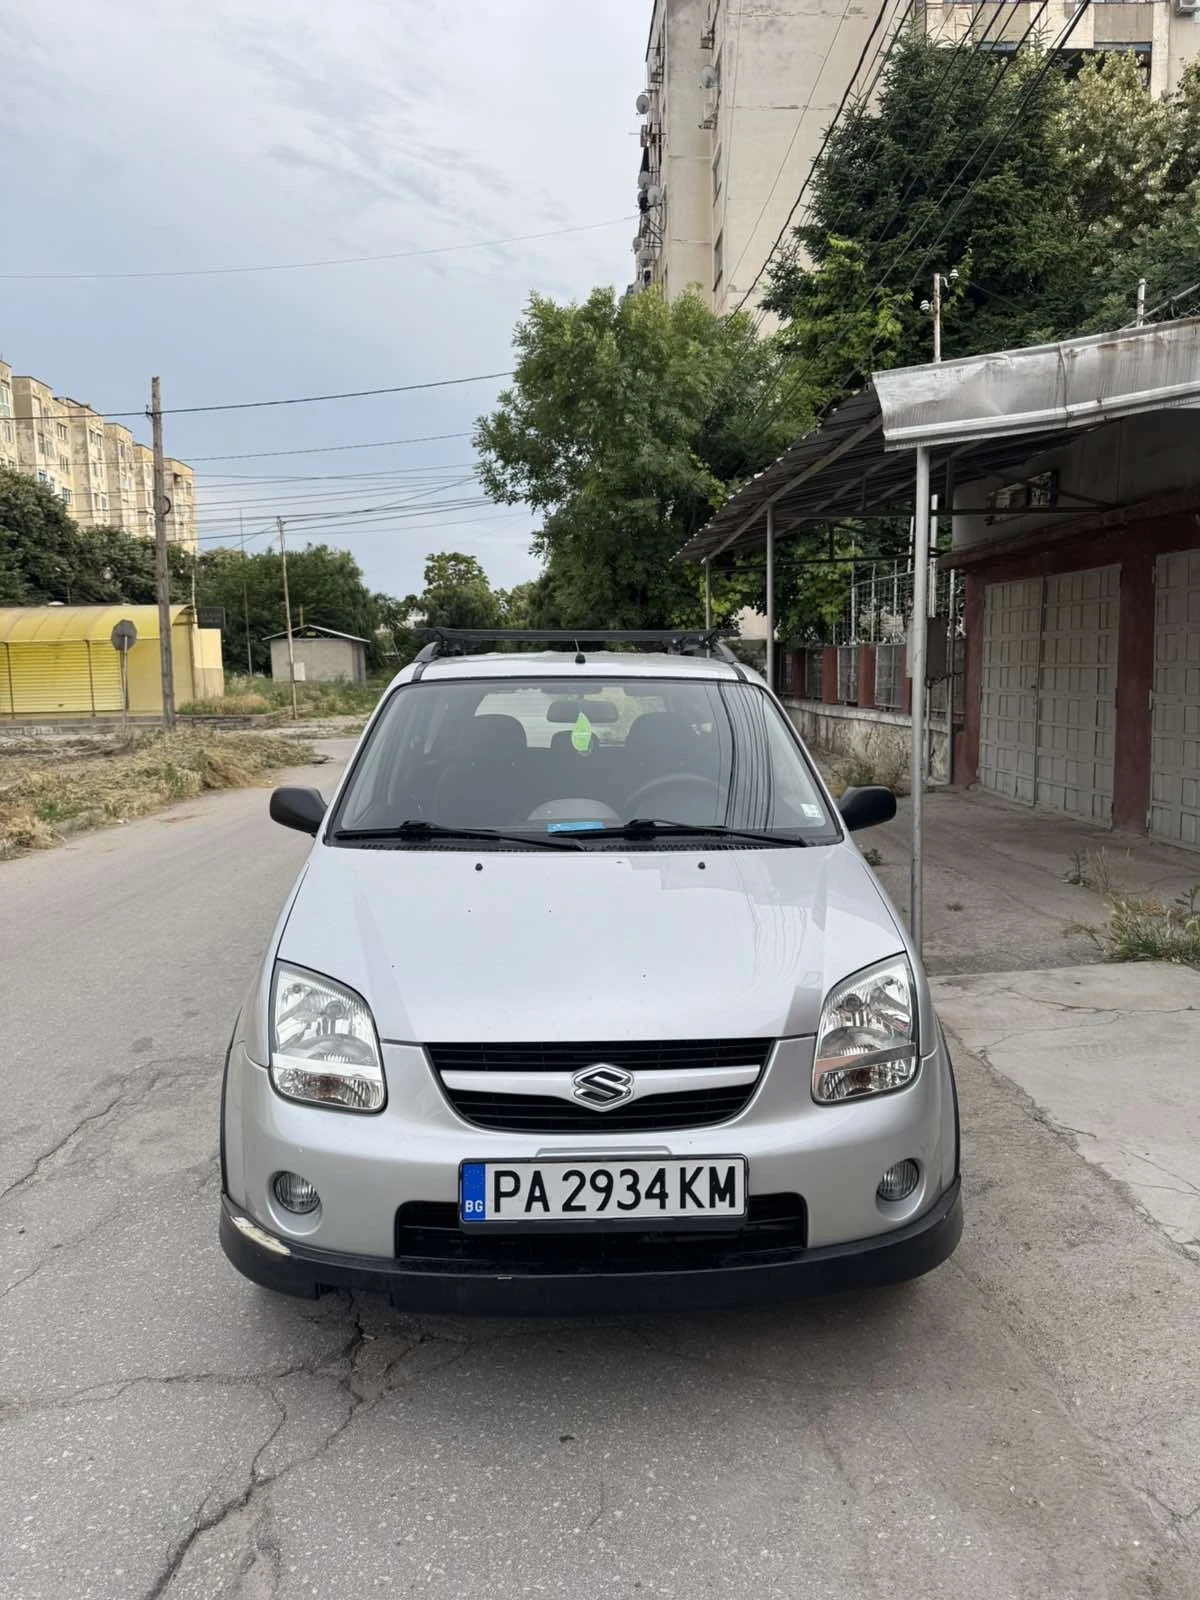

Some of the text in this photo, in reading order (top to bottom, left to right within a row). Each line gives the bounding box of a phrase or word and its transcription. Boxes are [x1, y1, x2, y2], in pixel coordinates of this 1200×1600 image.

[494, 1165, 736, 1213] PA 2934 KM
[465, 1200, 484, 1213] BG
